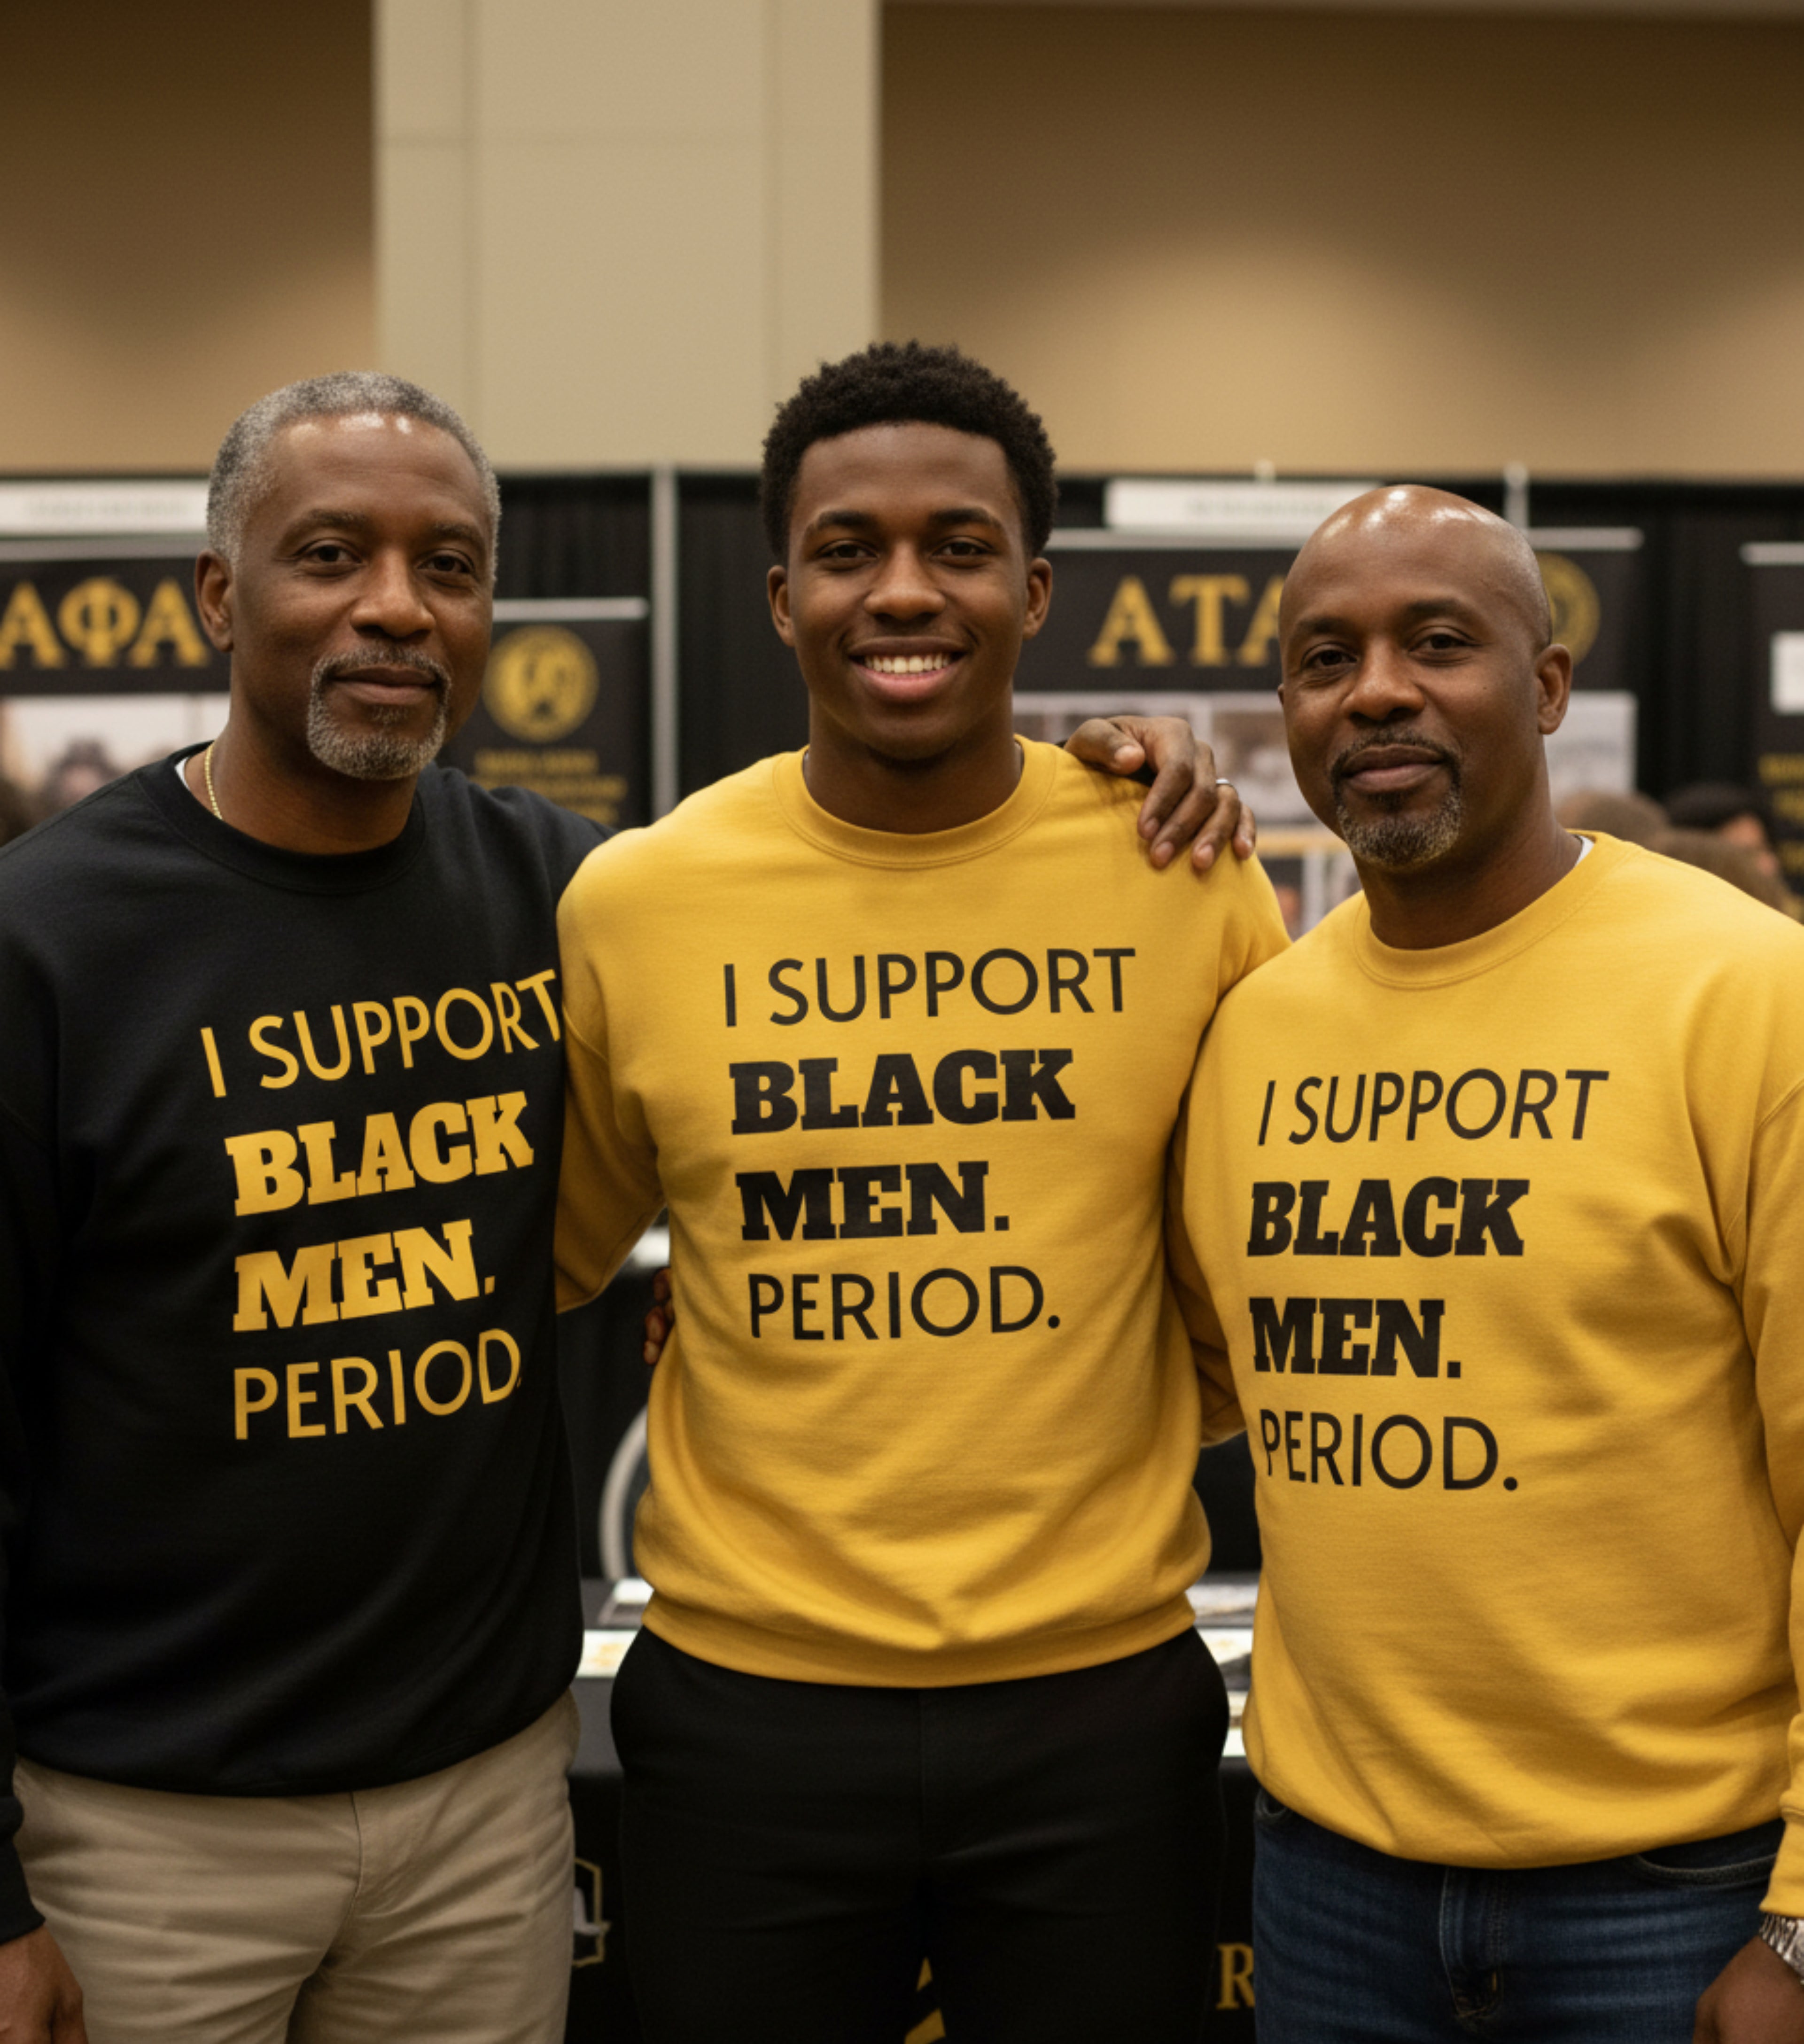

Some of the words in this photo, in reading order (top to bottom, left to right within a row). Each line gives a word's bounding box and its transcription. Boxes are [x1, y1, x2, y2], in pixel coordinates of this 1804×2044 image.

[724, 964, 737, 1027] I
[768, 948, 1136, 1025] SUPPORT
[200, 1027, 226, 1098] I
[249, 968, 561, 1089] SUPPORT
[729, 1048, 1076, 1136] BLACK
[1258, 1080, 1276, 1146] I
[1288, 1069, 1610, 1145] SUPPORT
[224, 1091, 534, 1217] BLACK
[734, 1160, 1010, 1241] MEN.
[1247, 1176, 1530, 1258] BLACK
[233, 1218, 495, 1332] MEN.
[748, 1265, 1061, 1341] PERIOD.
[1248, 1296, 1461, 1379] MEN.
[233, 1328, 521, 1440] PERIOD
[1259, 1408, 1518, 1491] PERIOD.
